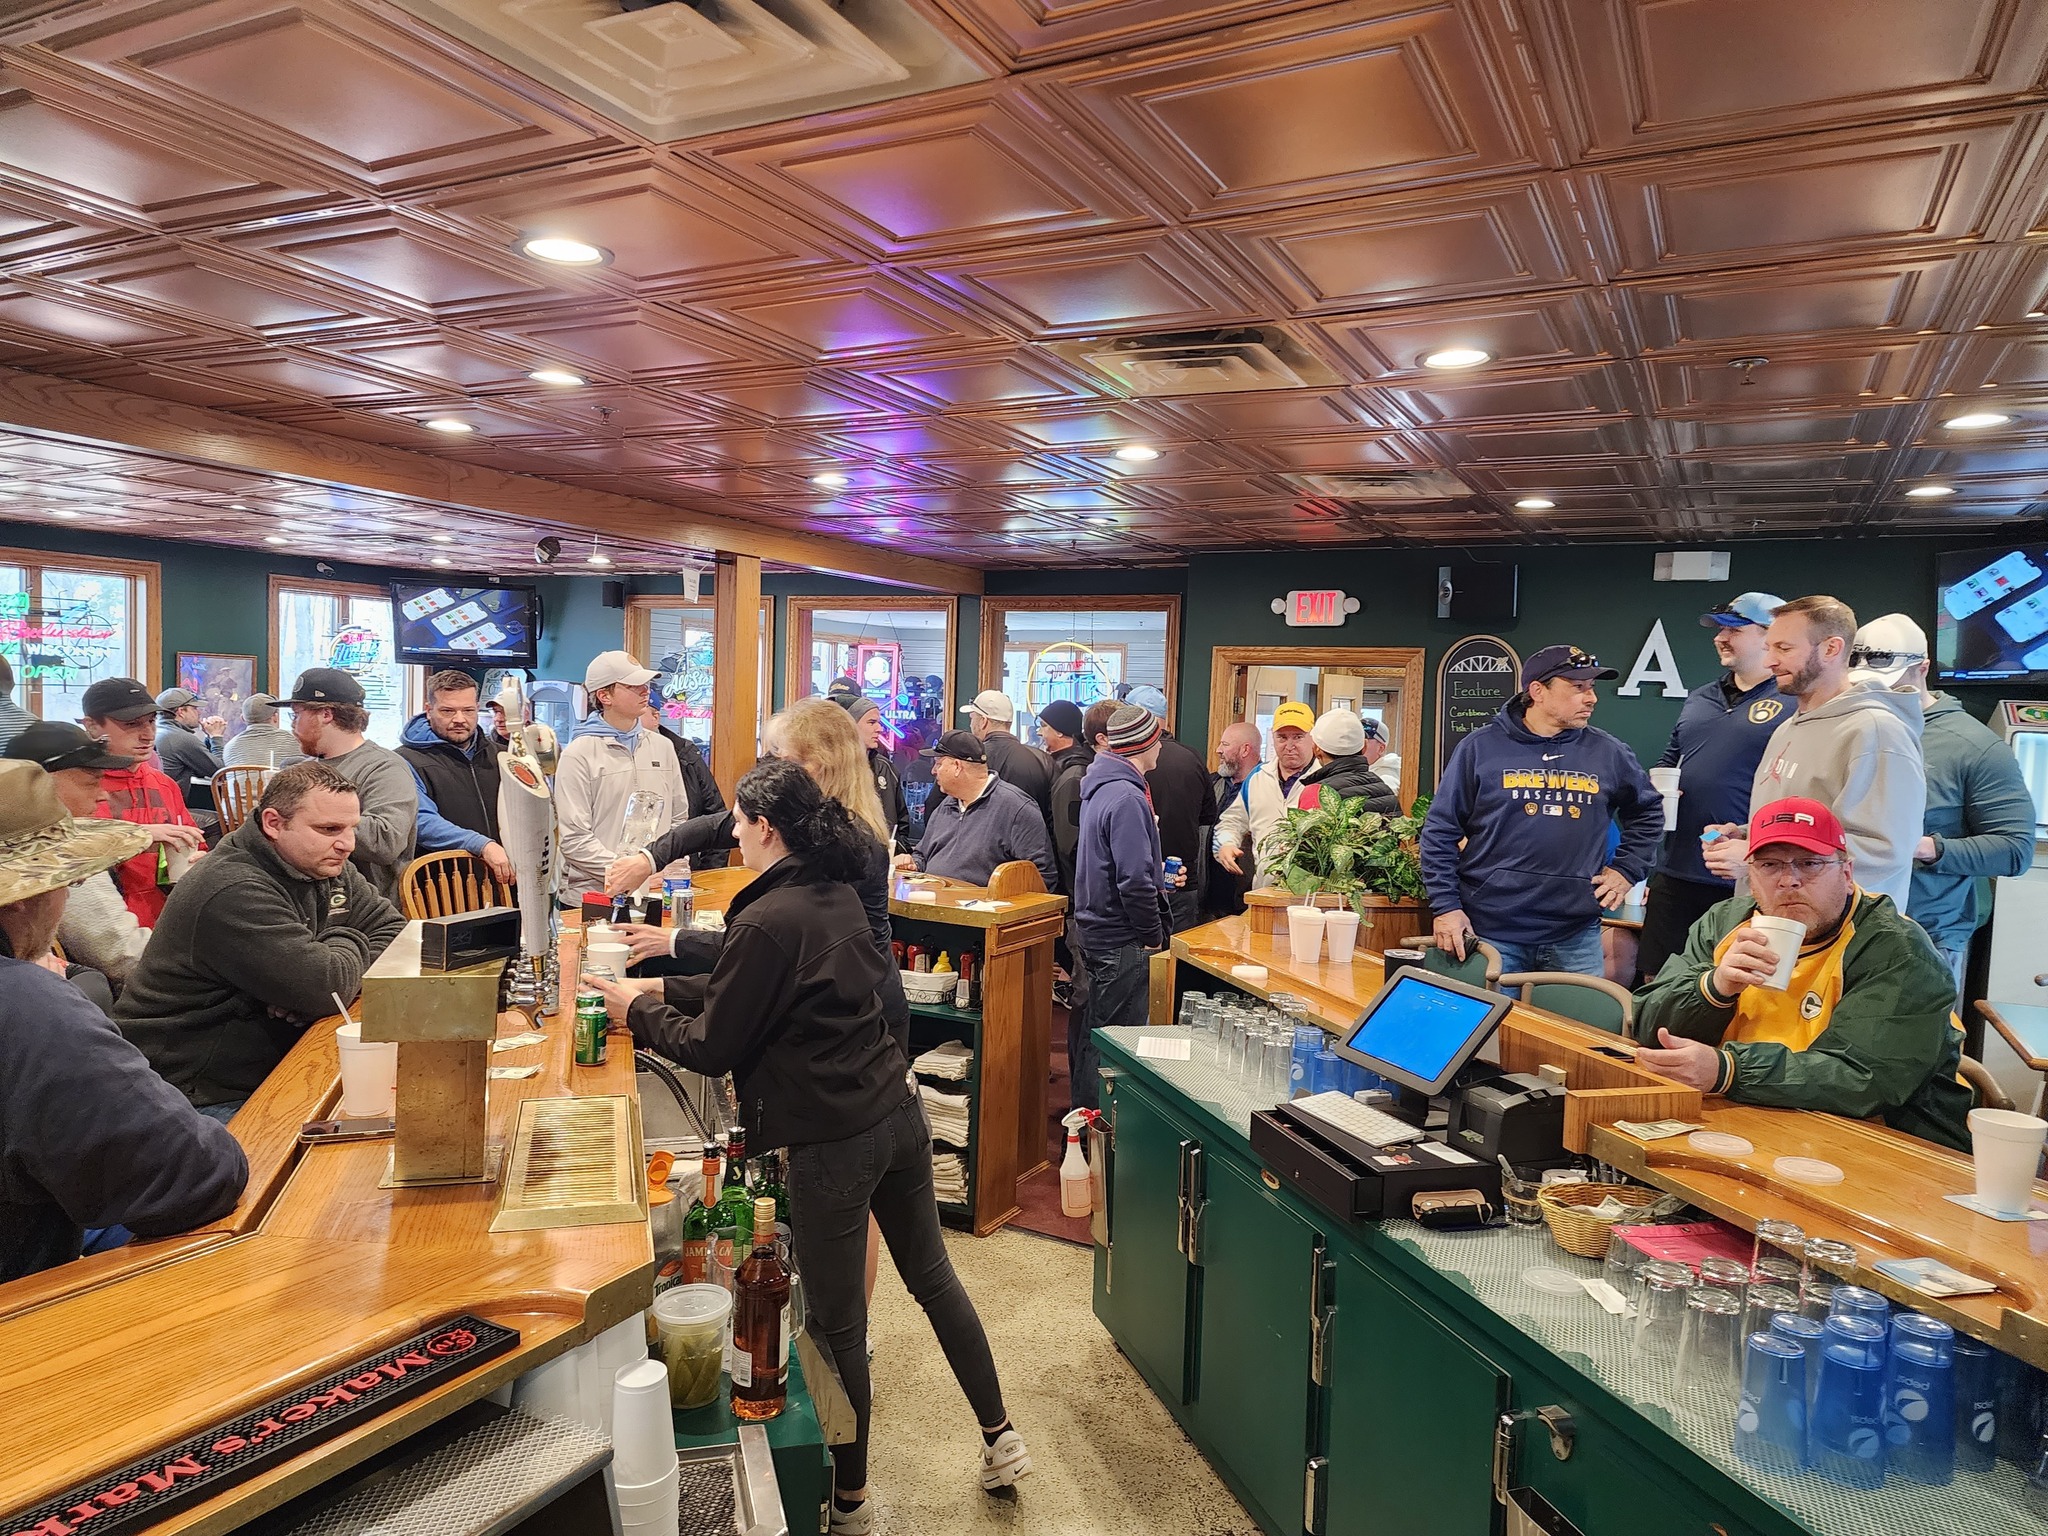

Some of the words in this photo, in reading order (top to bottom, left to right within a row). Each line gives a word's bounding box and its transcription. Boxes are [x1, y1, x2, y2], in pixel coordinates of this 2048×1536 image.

[1295, 592, 1337, 624] EXIT
[1617, 617, 1689, 698] A
[20, 664, 79, 681] OPEN
[1453, 680, 1502, 697] Feature
[884, 709, 917, 721] ULTRA
[1449, 706, 1491, 718] Caribbean
[1503, 768, 1601, 795] BREWERS
[1511, 789, 1593, 805] BASEBALL
[1760, 812, 1815, 829] USA
[685, 1246, 733, 1257] JAMSON
[211, 1350, 434, 1455] Maker's
